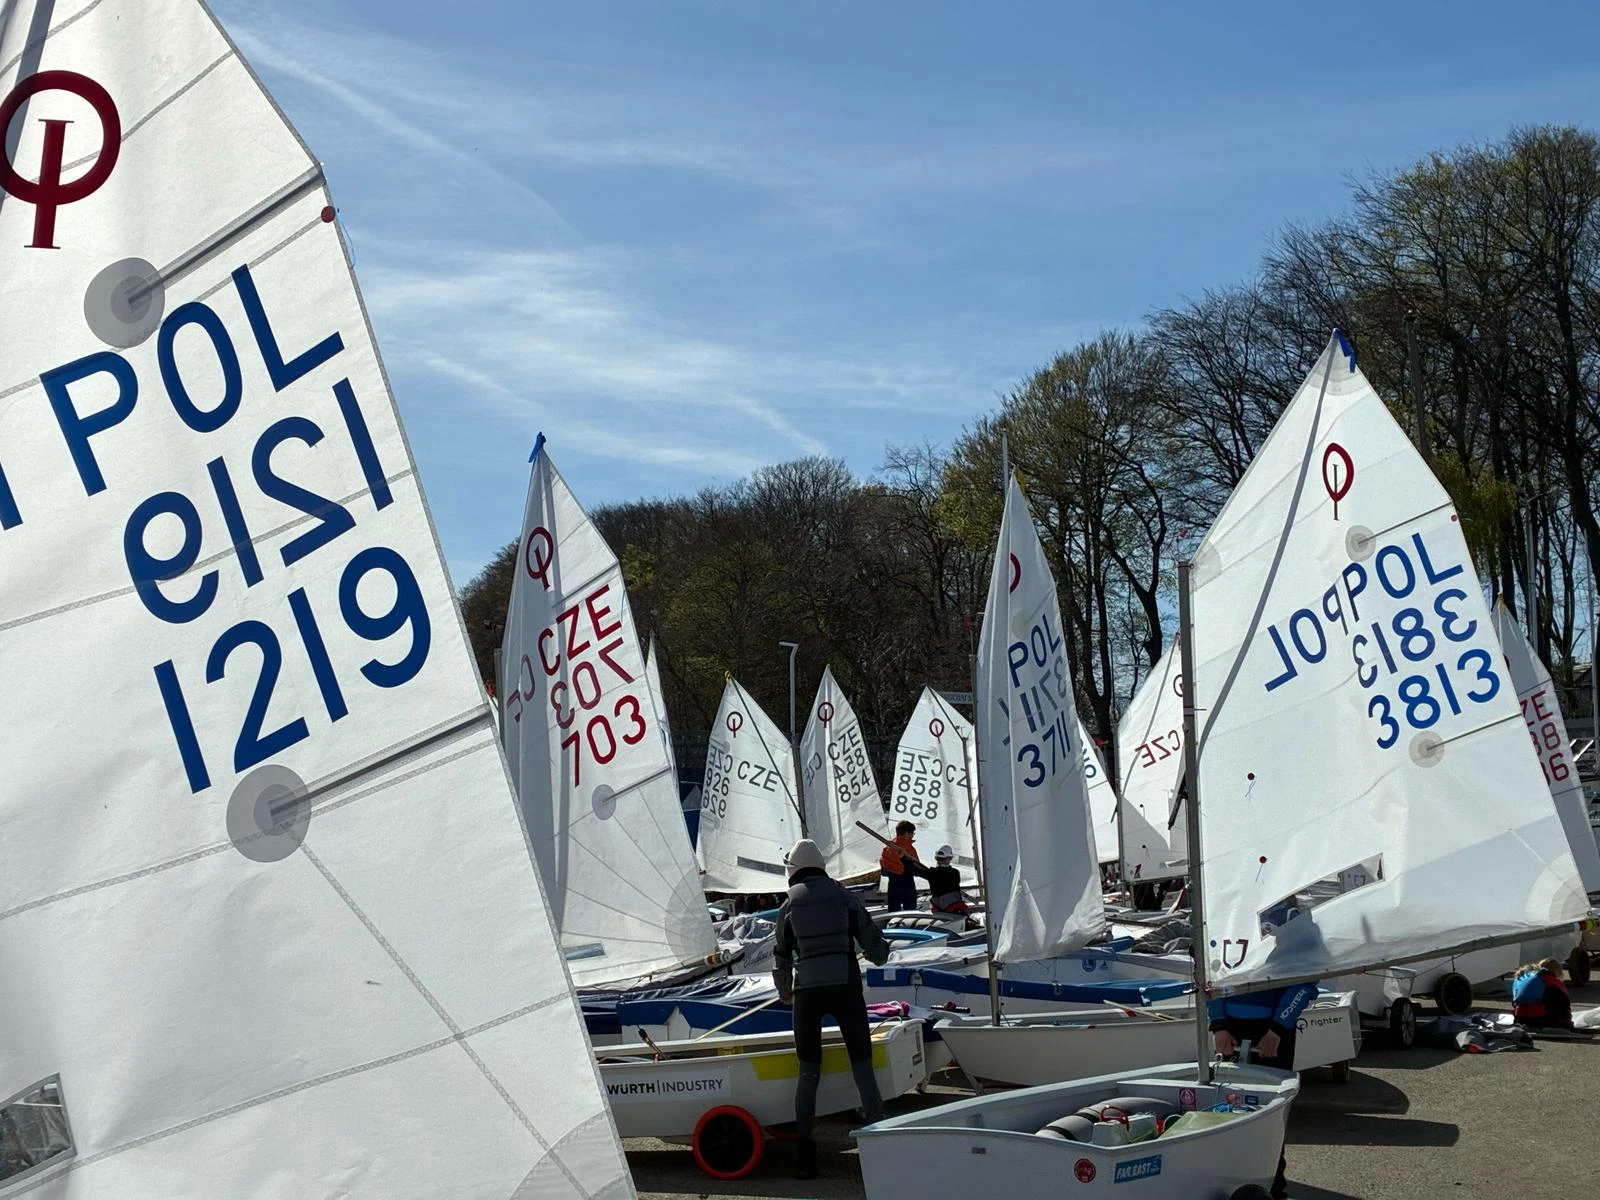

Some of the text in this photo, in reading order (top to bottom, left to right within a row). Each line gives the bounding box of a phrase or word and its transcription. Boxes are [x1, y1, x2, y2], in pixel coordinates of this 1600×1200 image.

[40, 263, 345, 496] POL
[1343, 532, 1464, 623] POL
[537, 584, 622, 676] CZE
[1008, 613, 1060, 689] POL
[153, 546, 431, 794] 1219
[1368, 648, 1500, 749] 3813
[562, 695, 647, 788] 703
[828, 726, 861, 761] CZE
[1017, 711, 1071, 788] 3711
[737, 760, 780, 792] CZE
[838, 769, 871, 803] 854
[898, 773, 941, 798] 858
[946, 764, 968, 788] CZ
[1310, 1017, 1343, 1027] fighter
[607, 1078, 724, 1095] WÜRTH INDUSTRY
[1116, 1162, 1152, 1180] FAR EAST
